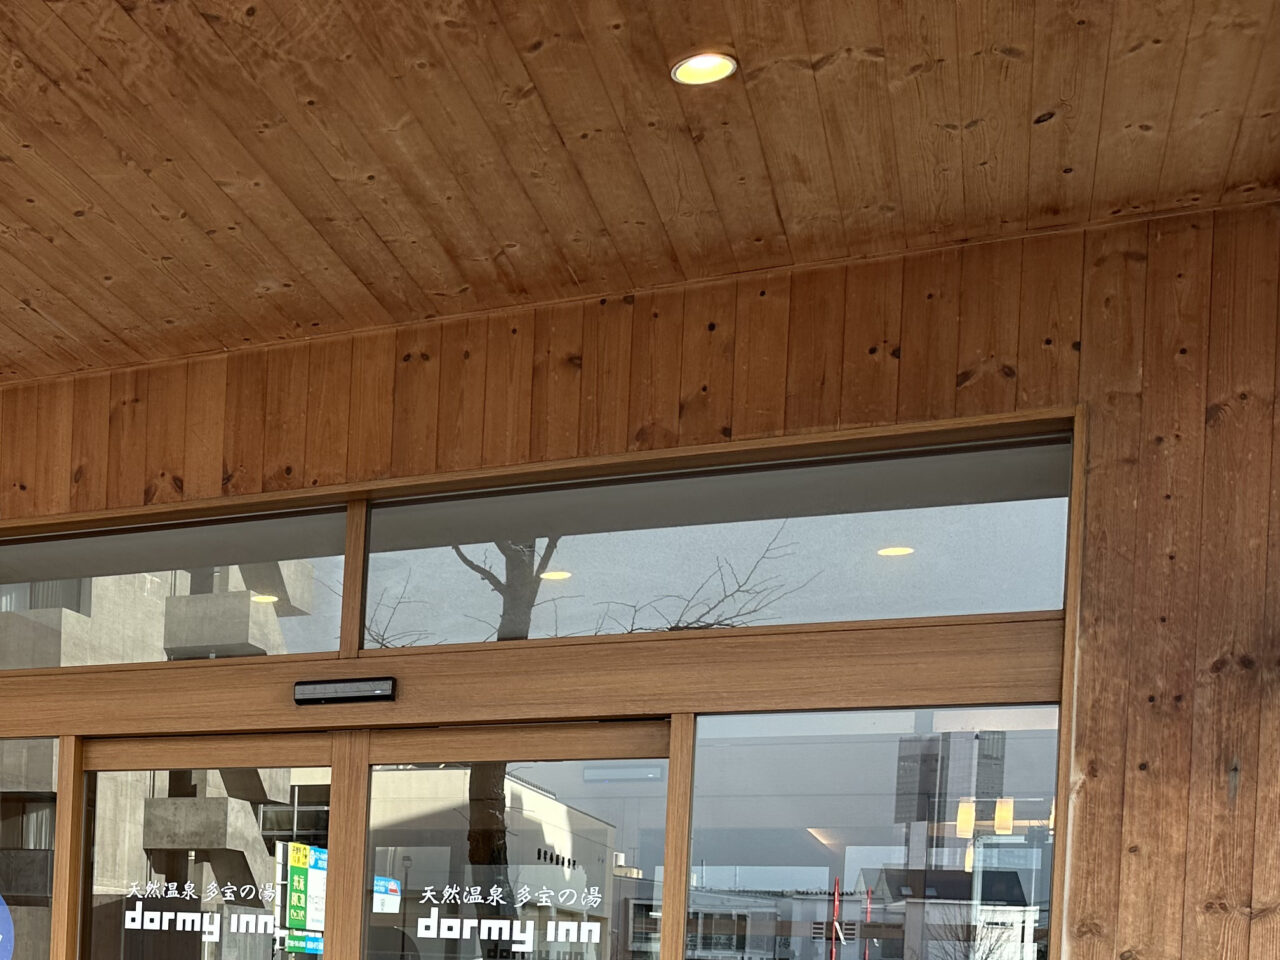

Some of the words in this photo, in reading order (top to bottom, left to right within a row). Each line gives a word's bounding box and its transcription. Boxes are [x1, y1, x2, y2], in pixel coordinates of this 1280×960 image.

[125, 880, 199, 900] 天然温泉
[204, 881, 276, 903] 多宝の湯
[418, 884, 507, 905] 天然温泉
[513, 885, 603, 909] 多宝の湯
[124, 900, 221, 942] dormy
[230, 913, 275, 934] inn
[416, 907, 535, 952] dormy
[546, 920, 601, 943] inn
